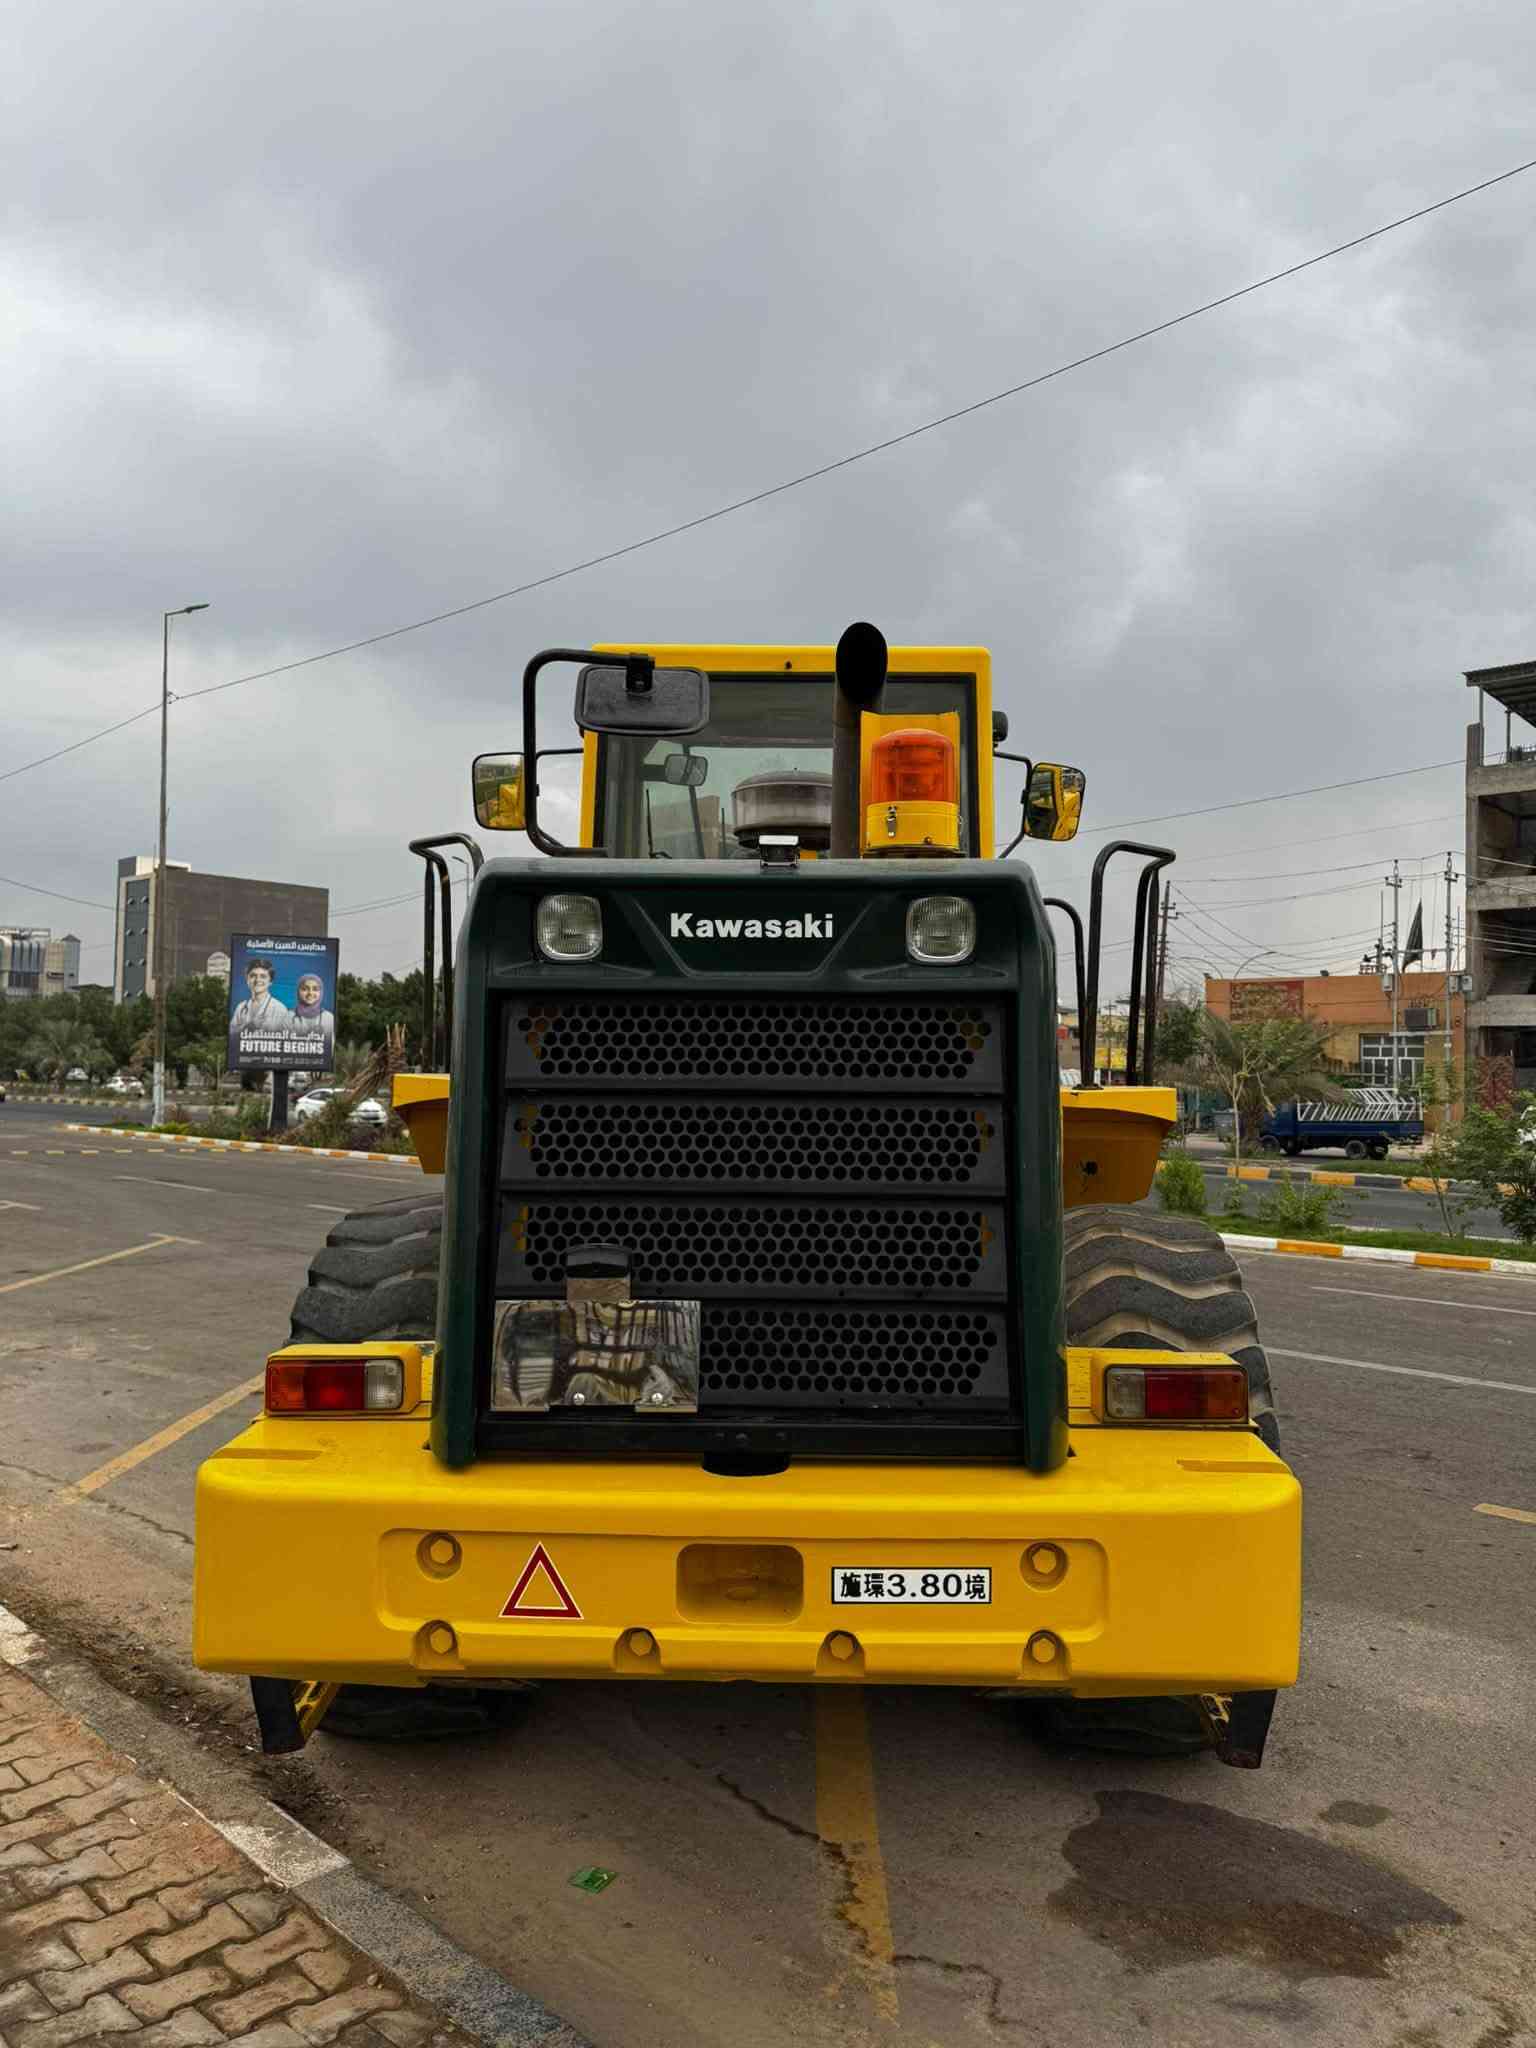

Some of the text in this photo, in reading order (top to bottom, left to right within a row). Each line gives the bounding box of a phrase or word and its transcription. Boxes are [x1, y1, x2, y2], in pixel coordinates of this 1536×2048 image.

[670, 913, 834, 938] Kawasaki
[240, 1040, 324, 1055] FUTURE BEGINS
